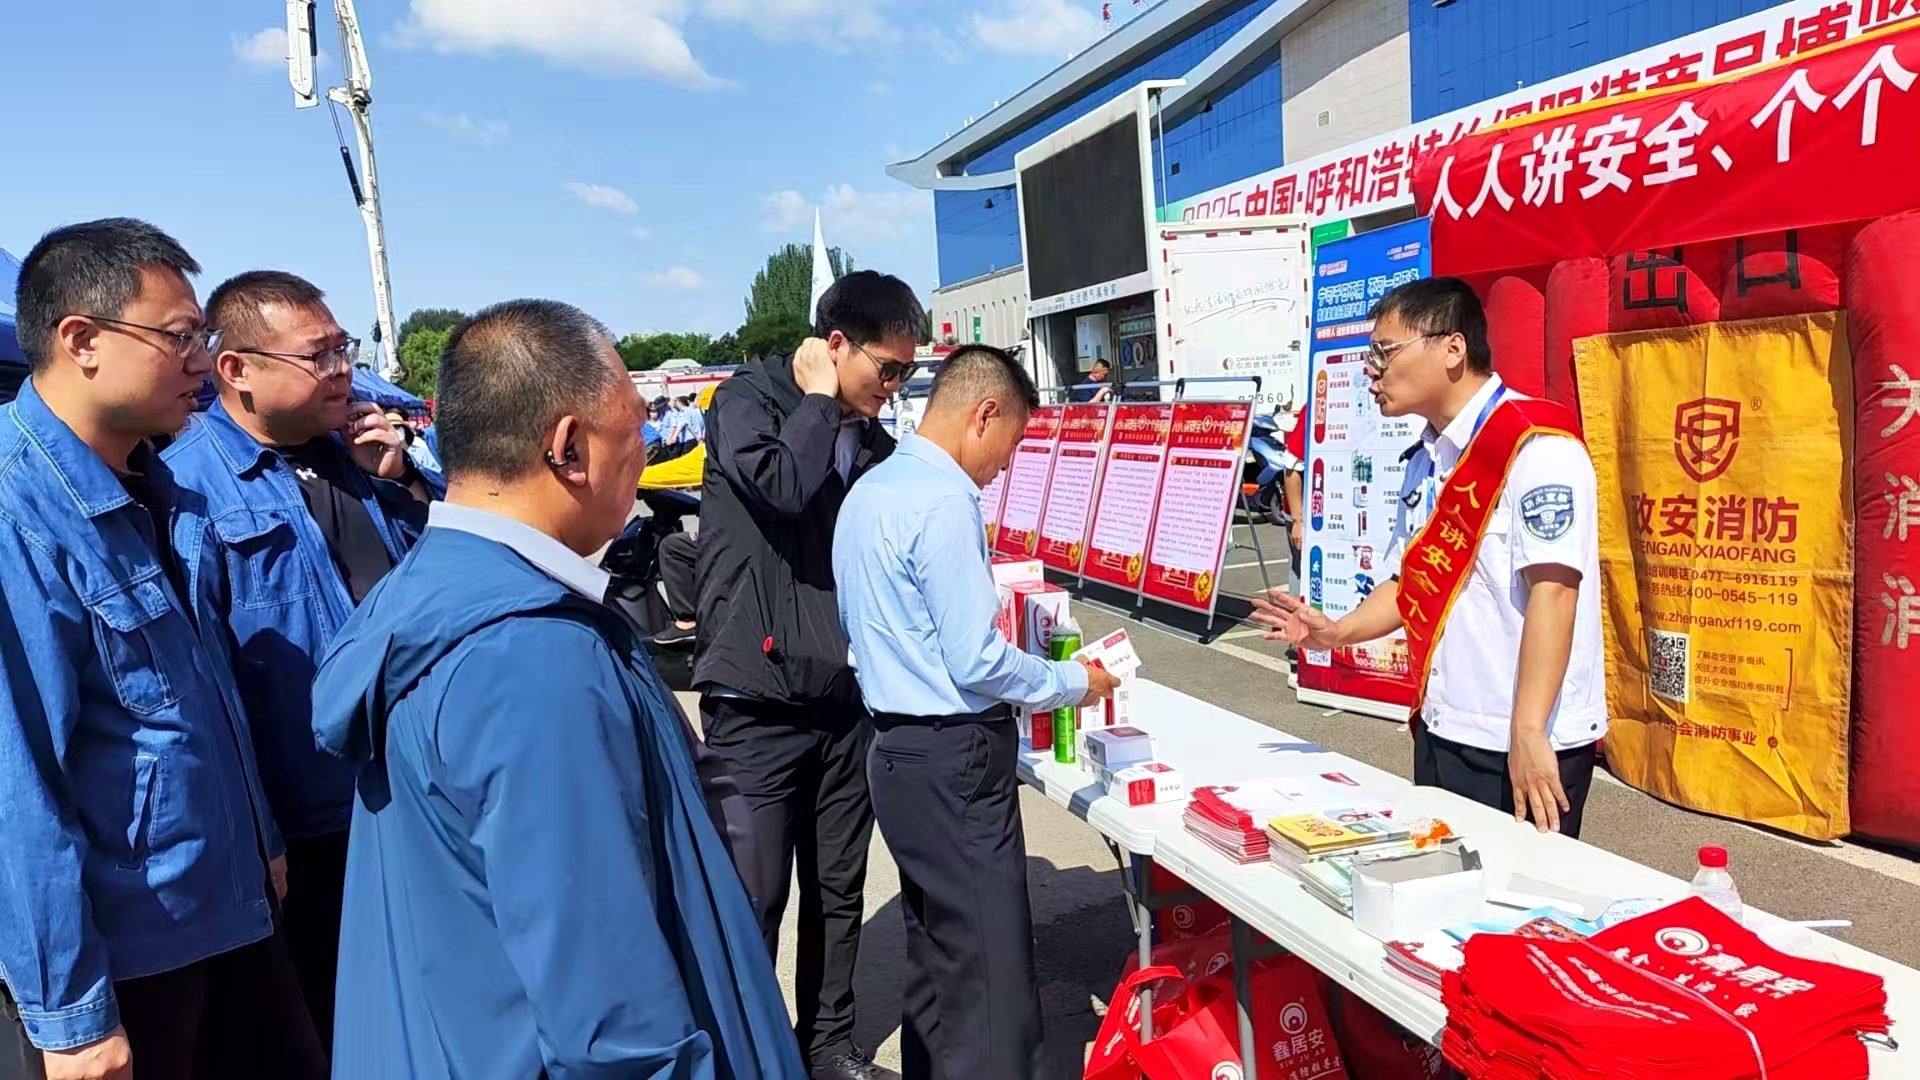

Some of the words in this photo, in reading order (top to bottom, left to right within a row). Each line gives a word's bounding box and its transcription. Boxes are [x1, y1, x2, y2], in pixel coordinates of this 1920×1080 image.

[1429, 45, 1919, 221] 人人讲安全、个个
[1696, 544, 1797, 564] XIAOFANG
[1272, 1028, 1325, 1062] 鑫居安
